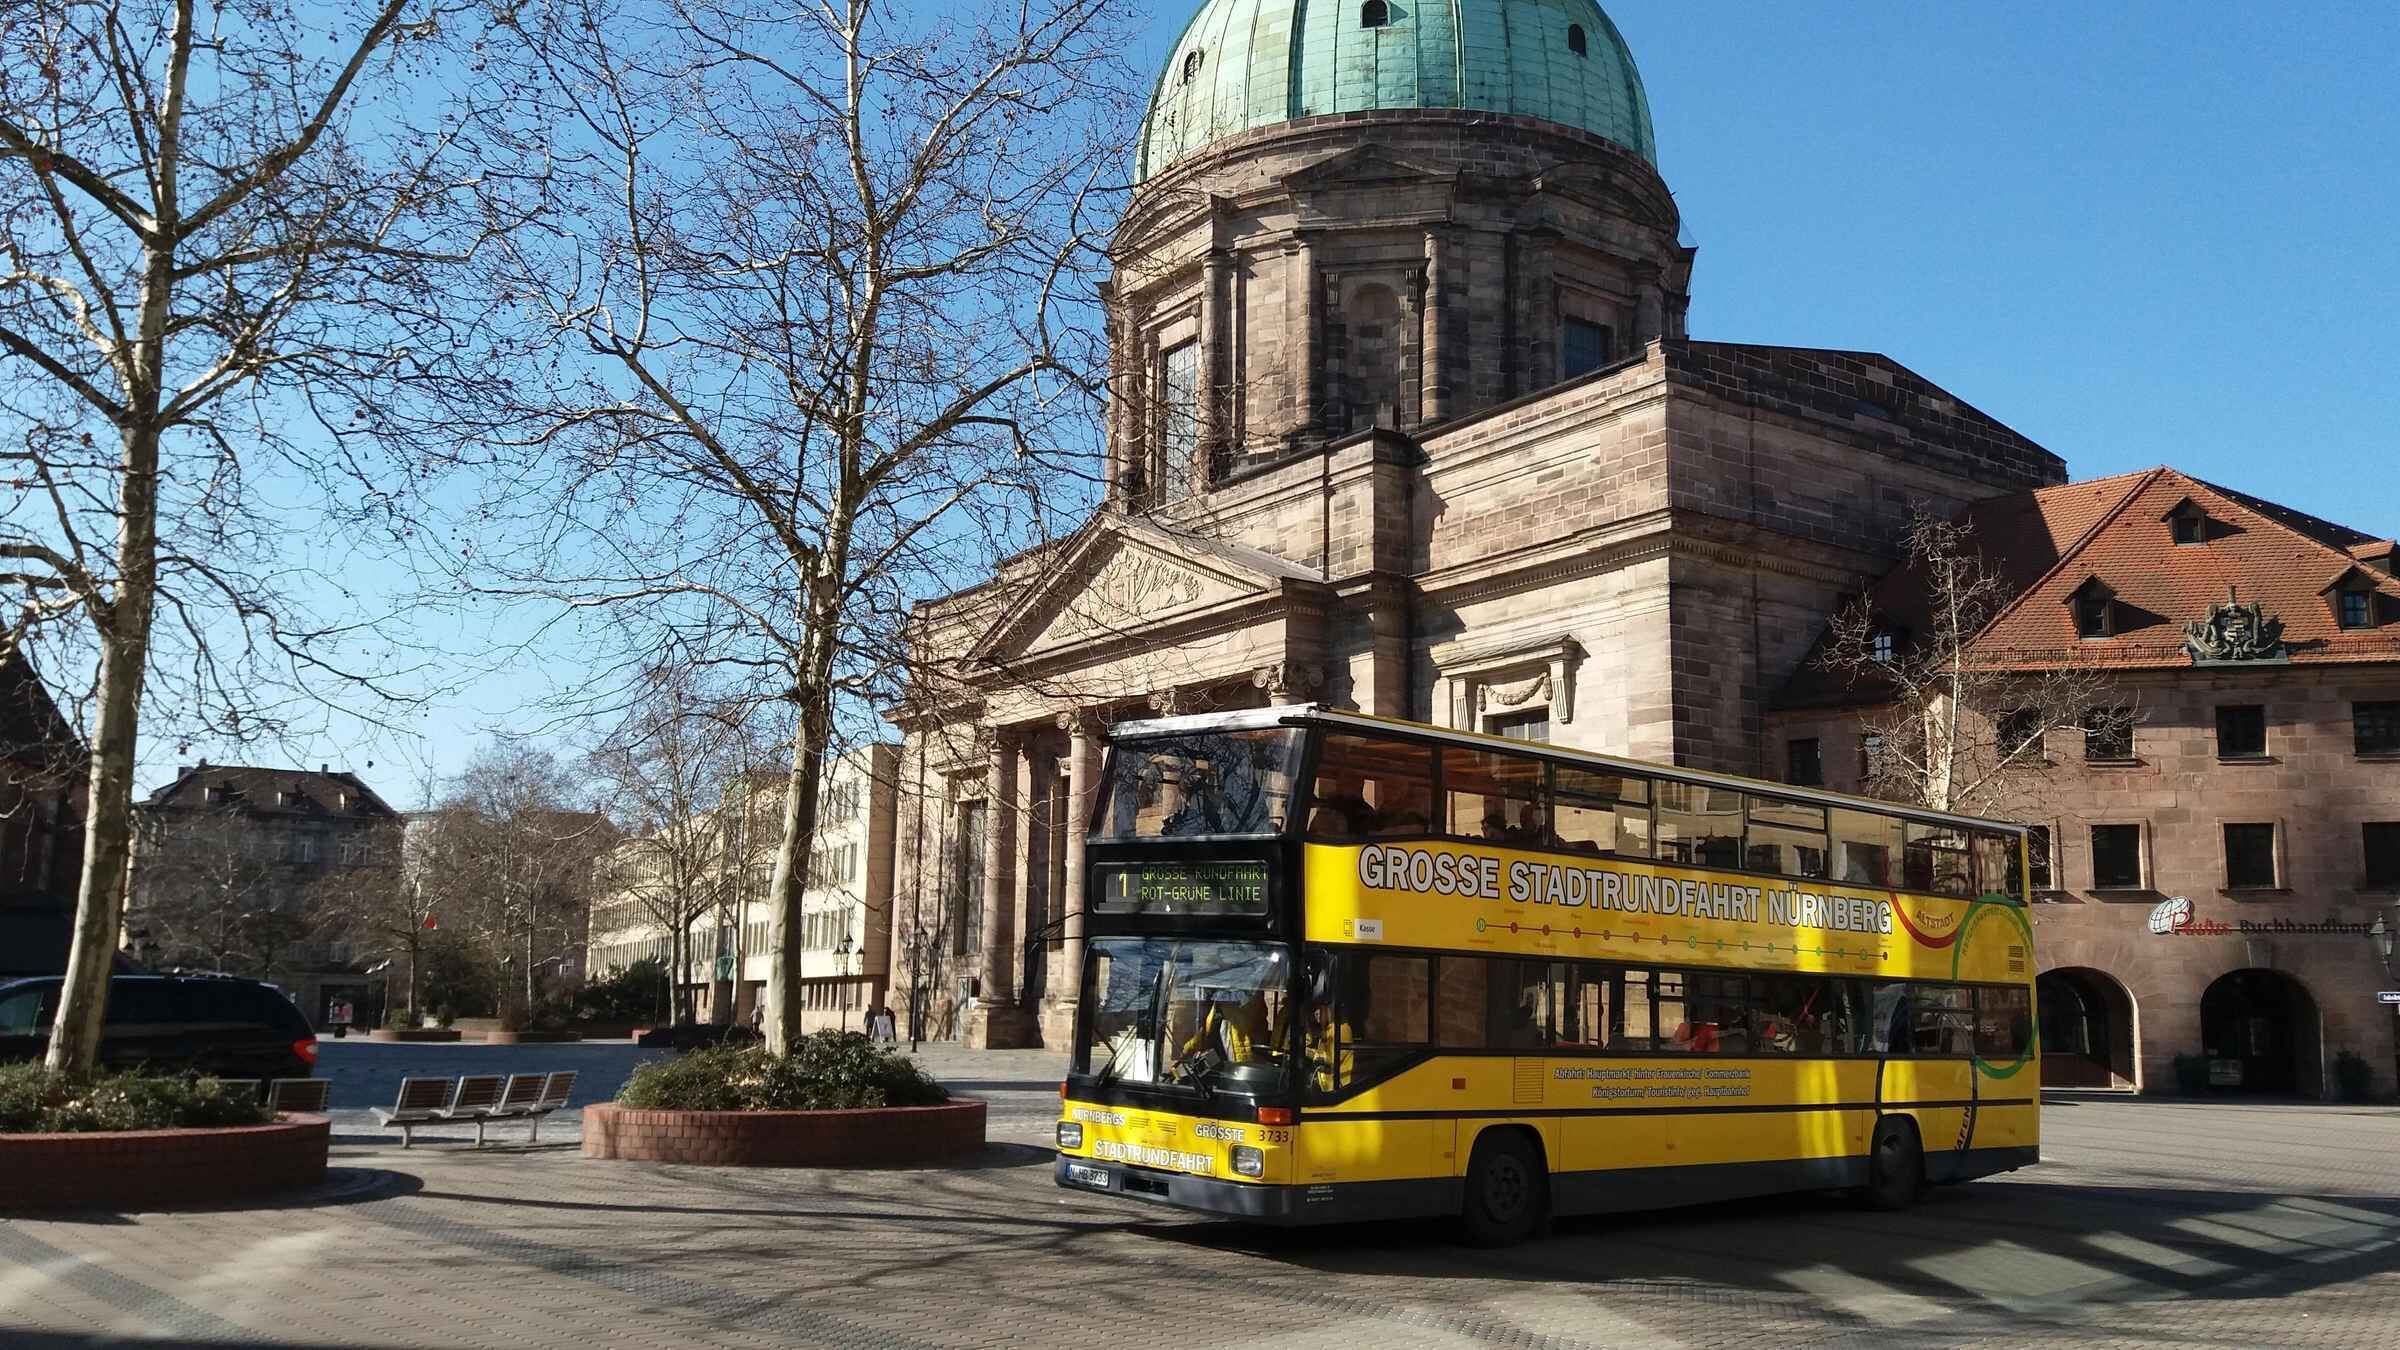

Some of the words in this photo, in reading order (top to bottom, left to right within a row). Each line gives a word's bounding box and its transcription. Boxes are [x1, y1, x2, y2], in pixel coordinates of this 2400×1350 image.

[1141, 865, 1188, 880] GROSSE
[1196, 864, 1268, 880] RUNDFAHRT
[1118, 873, 1128, 897] 1
[1219, 886, 1261, 900] LINIE
[1358, 843, 1500, 899] GROSSE
[1508, 860, 1762, 925] STADTRUNDFAHRT
[1767, 883, 1894, 935] NÜRNBERG
[1916, 910, 1955, 928] ALTSTADT
[1195, 1122, 1245, 1142] GRÖSSTE
[1258, 1129, 1289, 1143] 3733
[1095, 1139, 1213, 1173] STADTRUNDFAHRT
